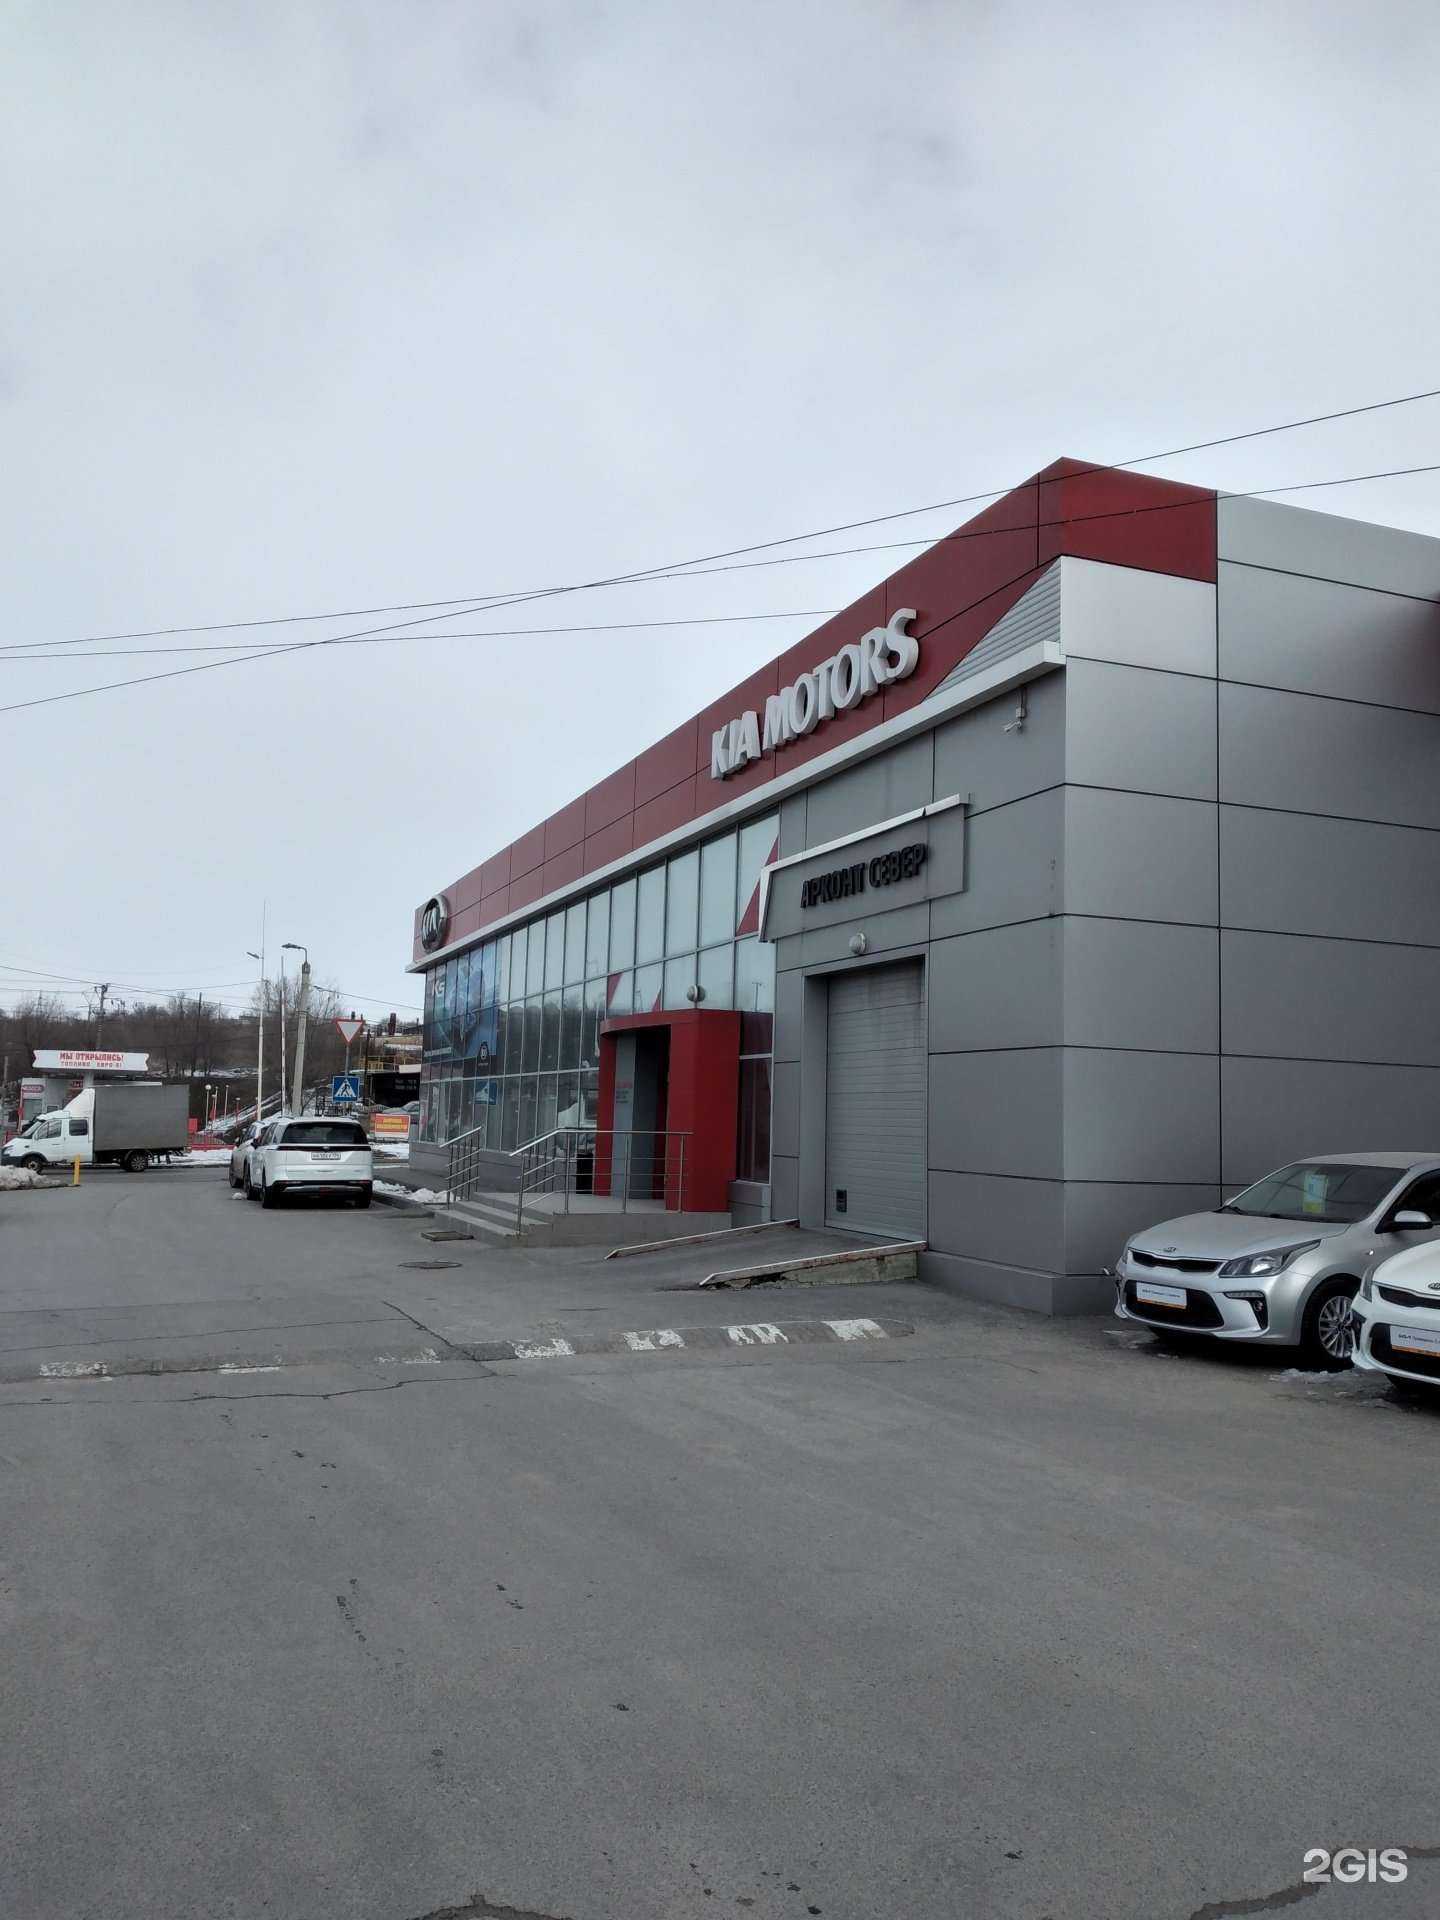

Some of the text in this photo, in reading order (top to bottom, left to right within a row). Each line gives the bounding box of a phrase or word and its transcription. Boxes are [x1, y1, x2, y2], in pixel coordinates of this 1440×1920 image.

[711, 607, 919, 779] KIA MOTORS
[800, 843, 930, 909] АРКОНТ СЕВЕР
[60, 1052, 124, 1062] МЫ ОТКРЫЛИСЬ!
